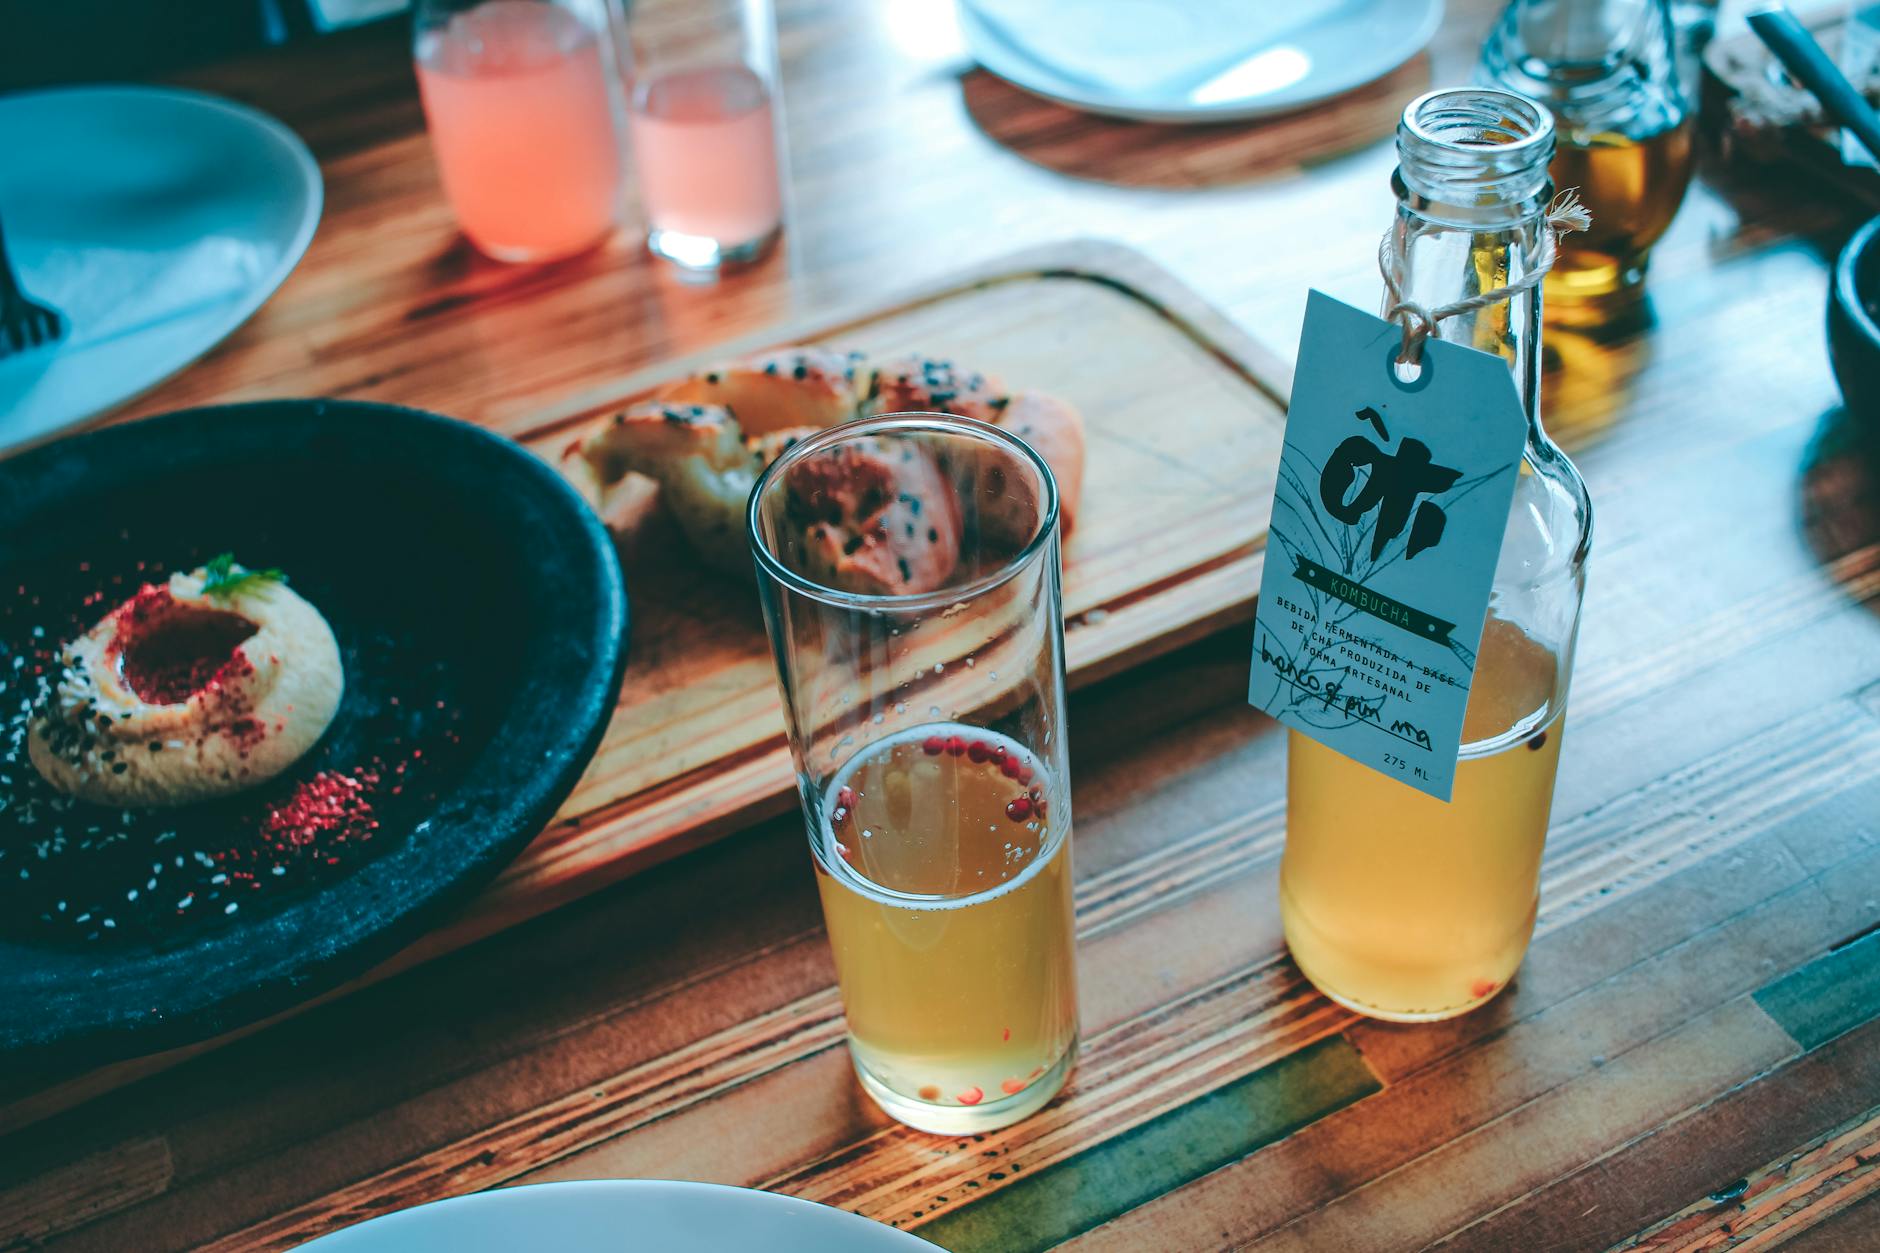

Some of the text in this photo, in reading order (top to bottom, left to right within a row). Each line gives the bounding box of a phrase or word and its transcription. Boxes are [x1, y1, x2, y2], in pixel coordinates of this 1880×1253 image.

[1330, 578, 1410, 627] KOMBUCHA
[1276, 596, 1455, 686] BEBIDA FERMENTADA A BASE
[1291, 622, 1432, 694] DE CHÁ PRODUZIDA DE
[1303, 643, 1412, 703] FORMA ARTESANAL
[1383, 753, 1429, 781] 275 ML
